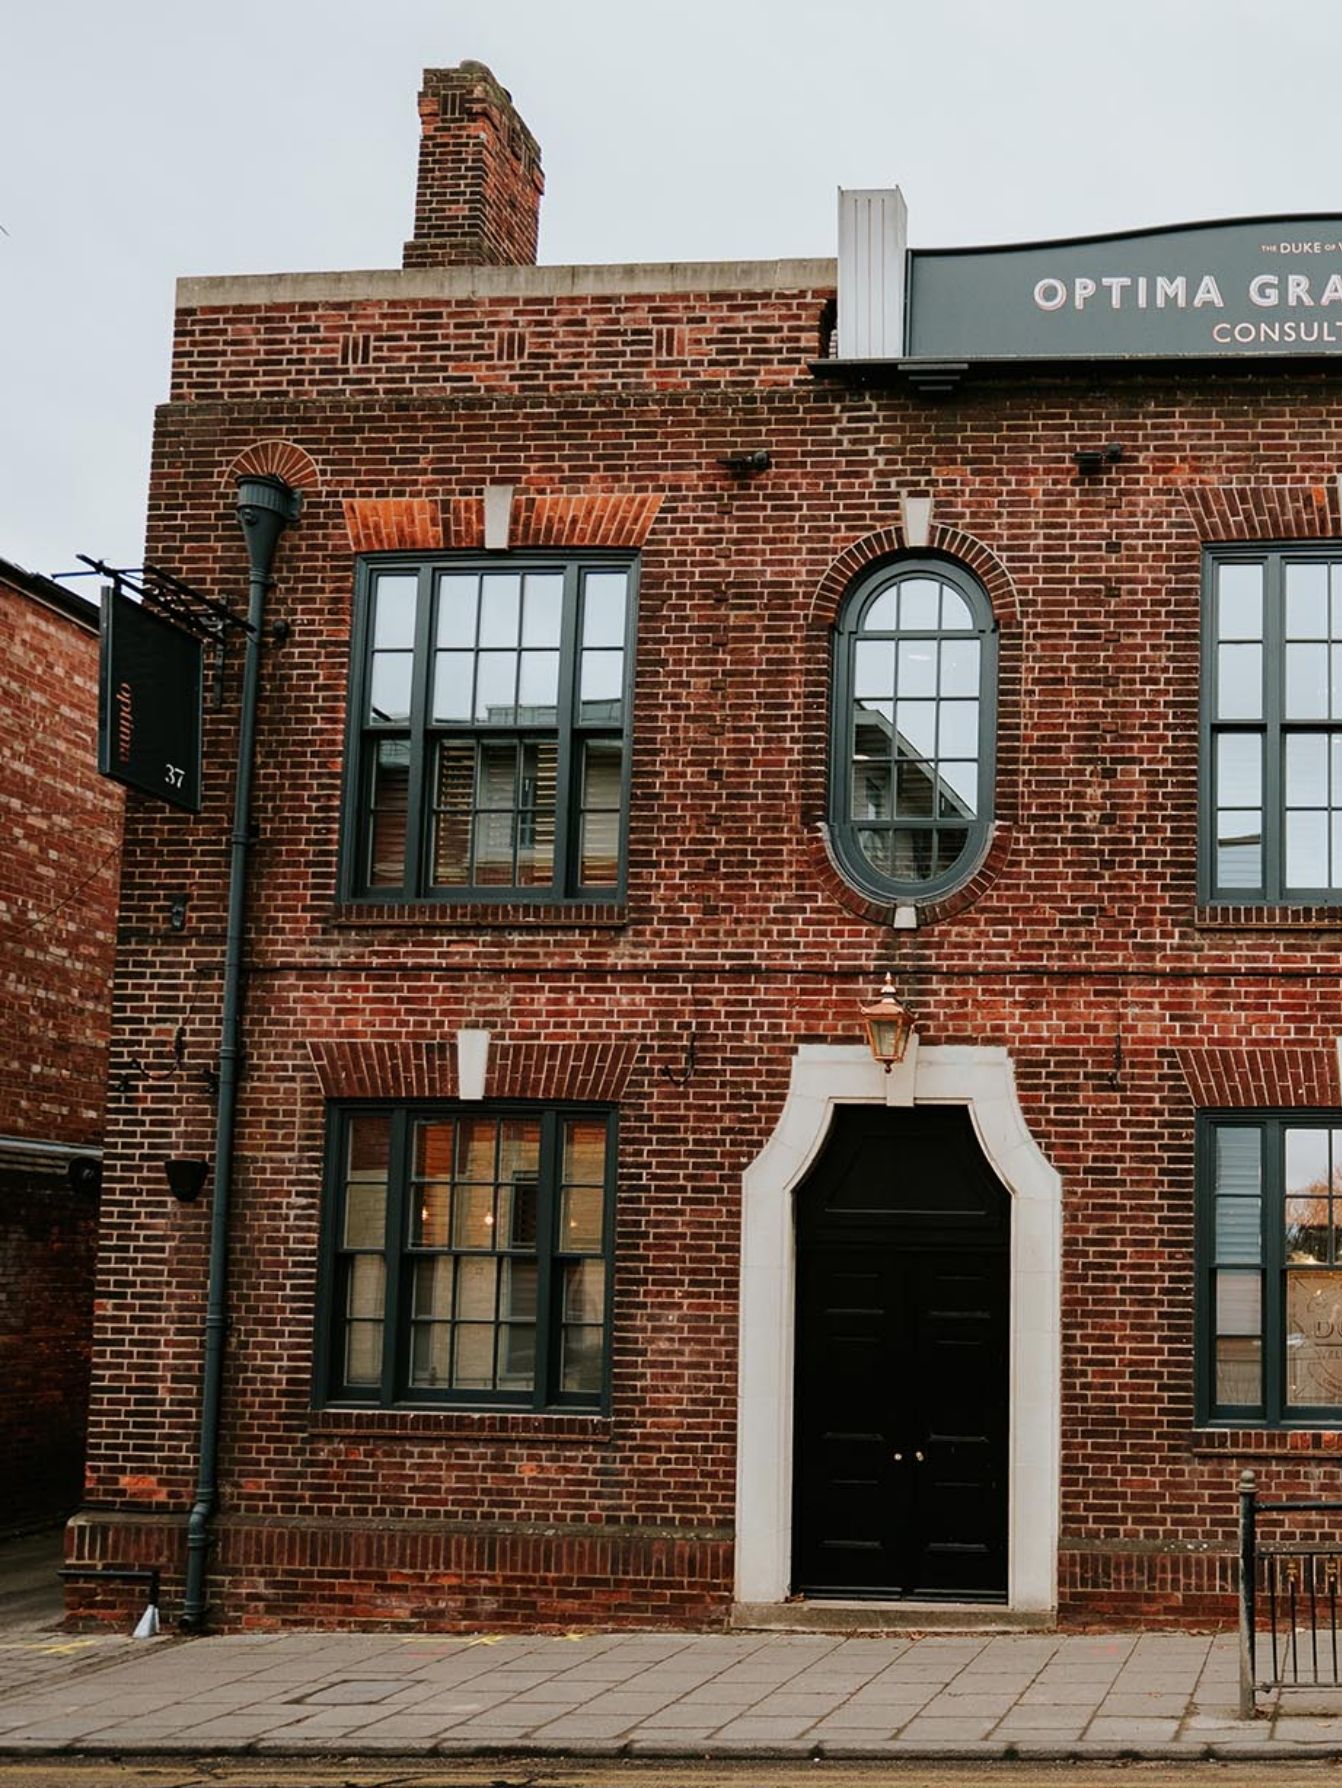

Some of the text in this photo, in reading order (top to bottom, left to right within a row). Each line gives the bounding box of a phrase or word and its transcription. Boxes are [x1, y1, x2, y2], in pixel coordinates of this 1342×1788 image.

[1280, 242, 1322, 254] DUKE
[1033, 275, 1225, 311] OPTIMA
[164, 763, 186, 789] 37
